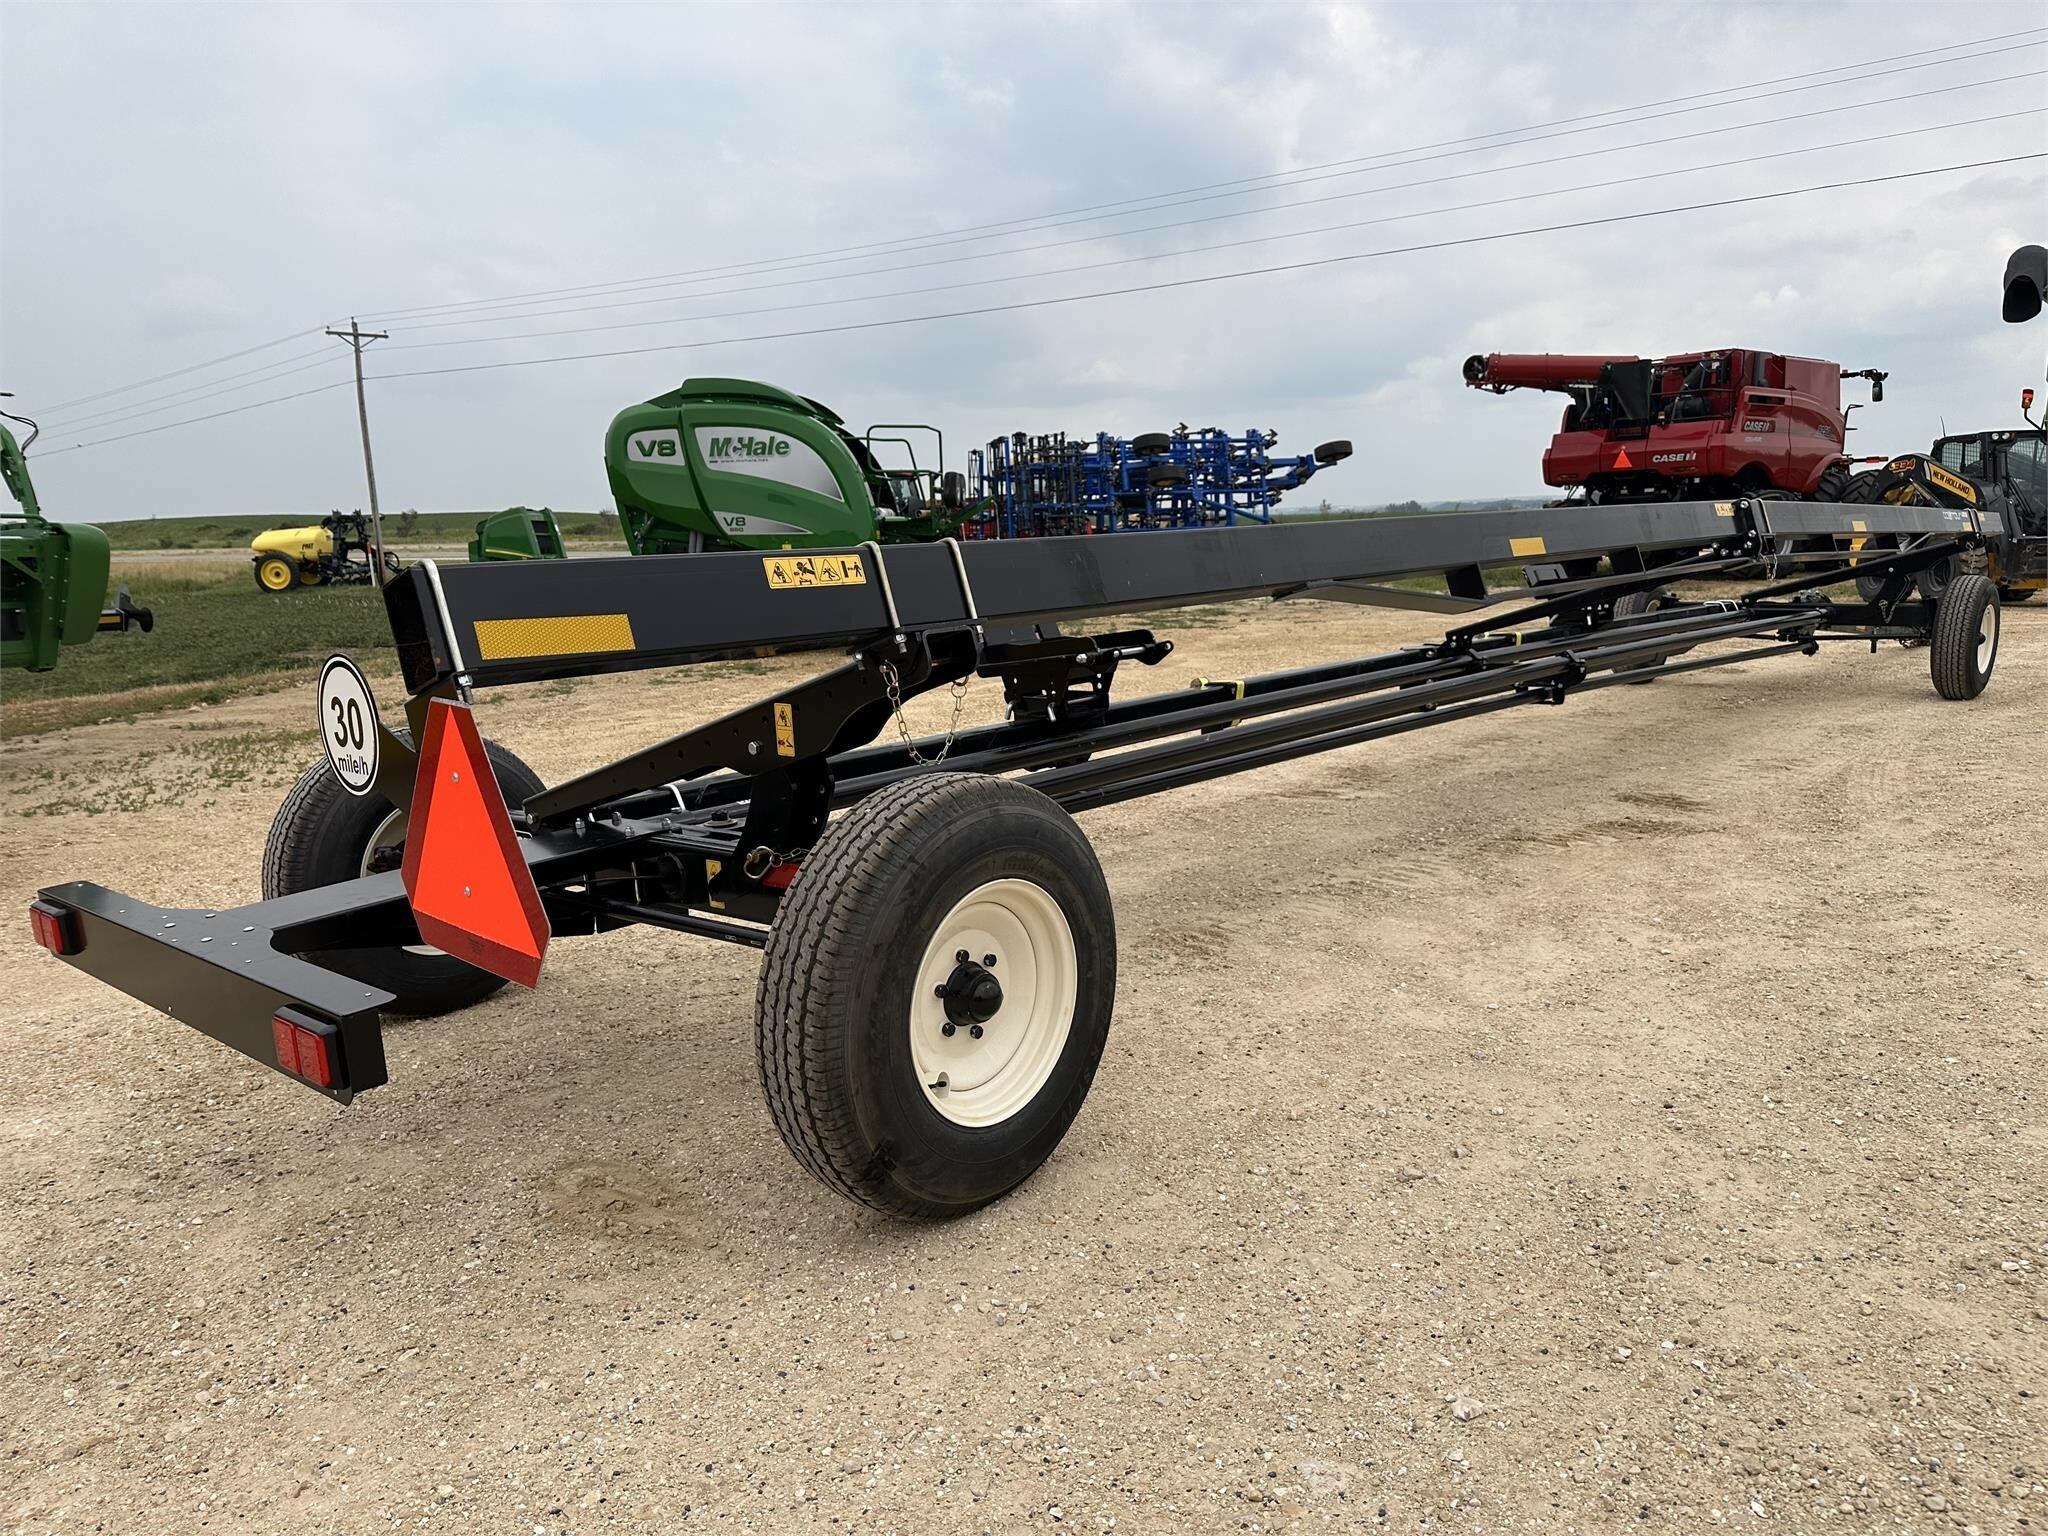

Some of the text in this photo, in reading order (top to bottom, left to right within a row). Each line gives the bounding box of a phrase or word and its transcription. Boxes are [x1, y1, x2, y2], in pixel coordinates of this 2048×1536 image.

[1743, 421, 1764, 432] CASE
[635, 439, 676, 457] V8
[709, 436, 790, 457] McHale
[1652, 453, 1685, 463] CASE
[1932, 470, 1970, 495] NEW HOLLAND
[723, 516, 746, 527] V8
[331, 696, 364, 751] 30
[338, 754, 369, 776] mile/h
